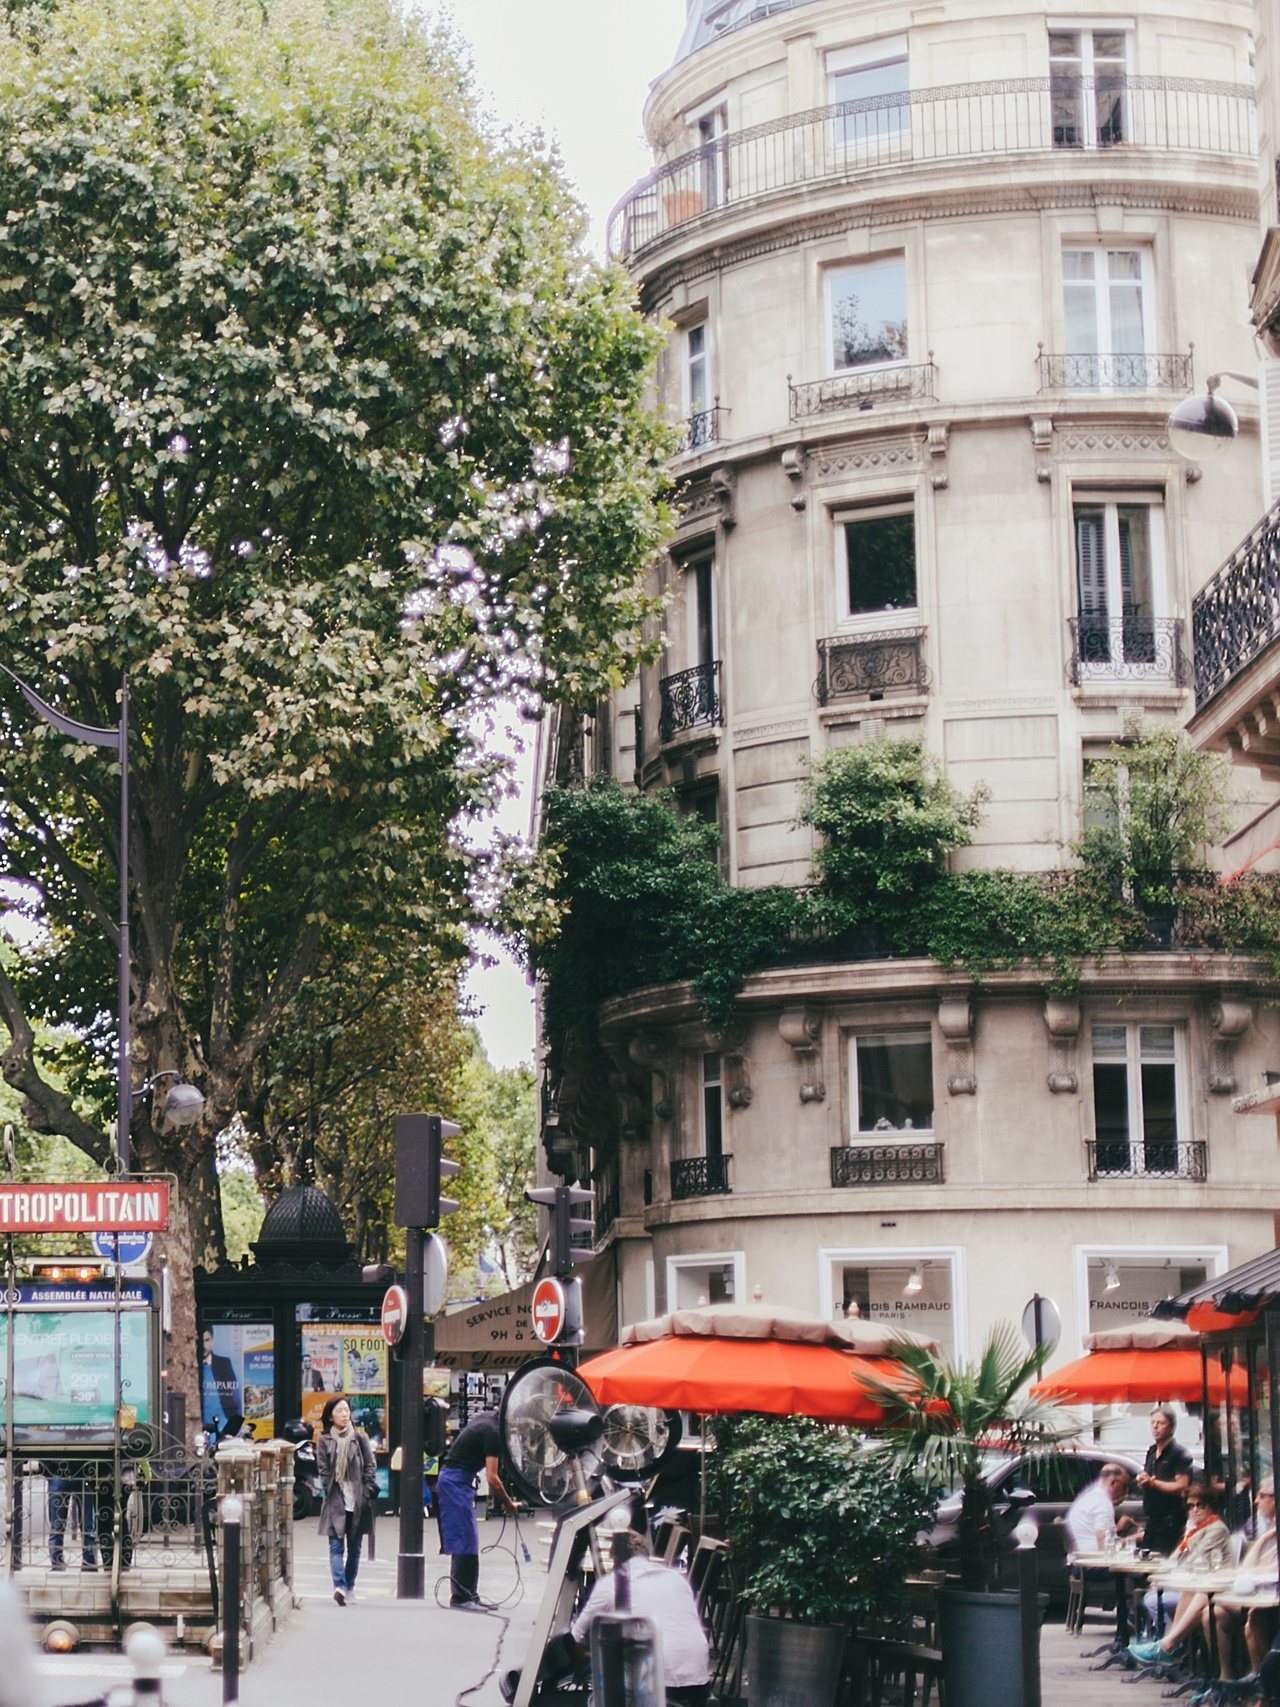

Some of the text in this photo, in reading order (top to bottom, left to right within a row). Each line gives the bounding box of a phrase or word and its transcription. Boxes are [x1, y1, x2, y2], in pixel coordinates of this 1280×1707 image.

[31, 1290, 87, 1301] ASSEMBLÉE
[895, 1301, 951, 1311] RAMBAUD
[1089, 1300, 1150, 1310] FRANCOIS
[466, 1306, 512, 1328] SERVICE
[516, 1320, 528, 1328] DE
[246, 1326, 270, 1337] vueling
[490, 1330, 508, 1340] 9H
[70, 1332, 128, 1346] FLEXIBE
[343, 1338, 357, 1351] SO
[360, 1338, 385, 1351] FOOT
[202, 1380, 239, 1390] OMPARD
